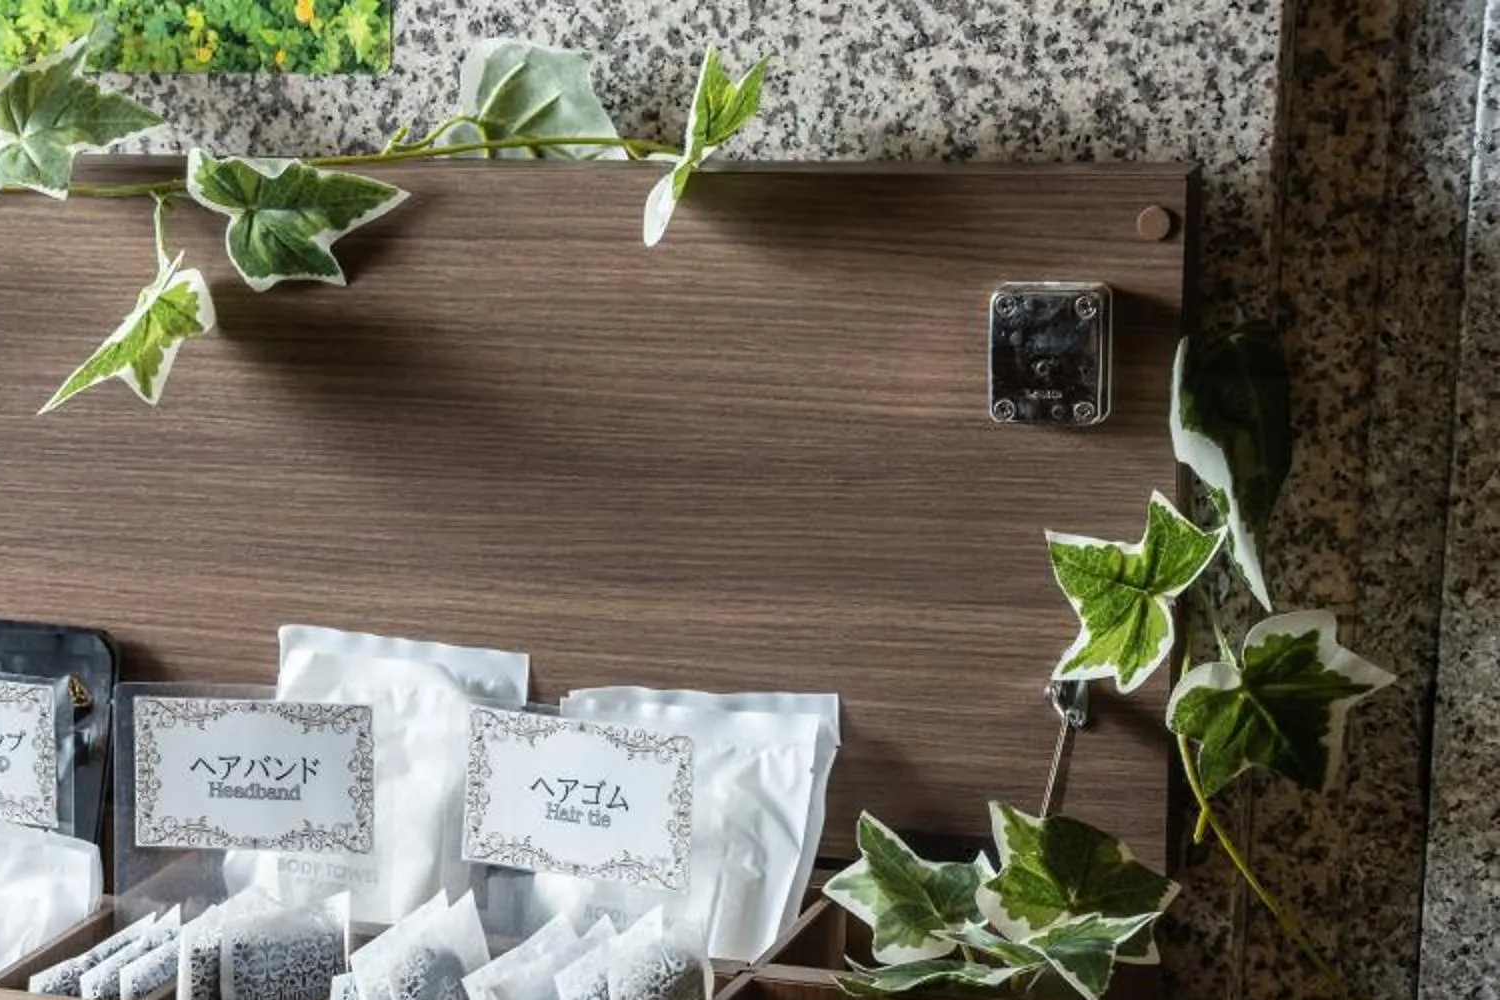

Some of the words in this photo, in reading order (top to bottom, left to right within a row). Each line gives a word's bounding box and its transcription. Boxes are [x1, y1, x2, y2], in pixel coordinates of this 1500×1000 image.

[190, 755, 320, 784] ヘアバンド
[209, 781, 301, 801] Headband
[530, 777, 629, 811] ヘアゴム
[545, 801, 584, 824] Hair
[587, 809, 612, 828] tie
